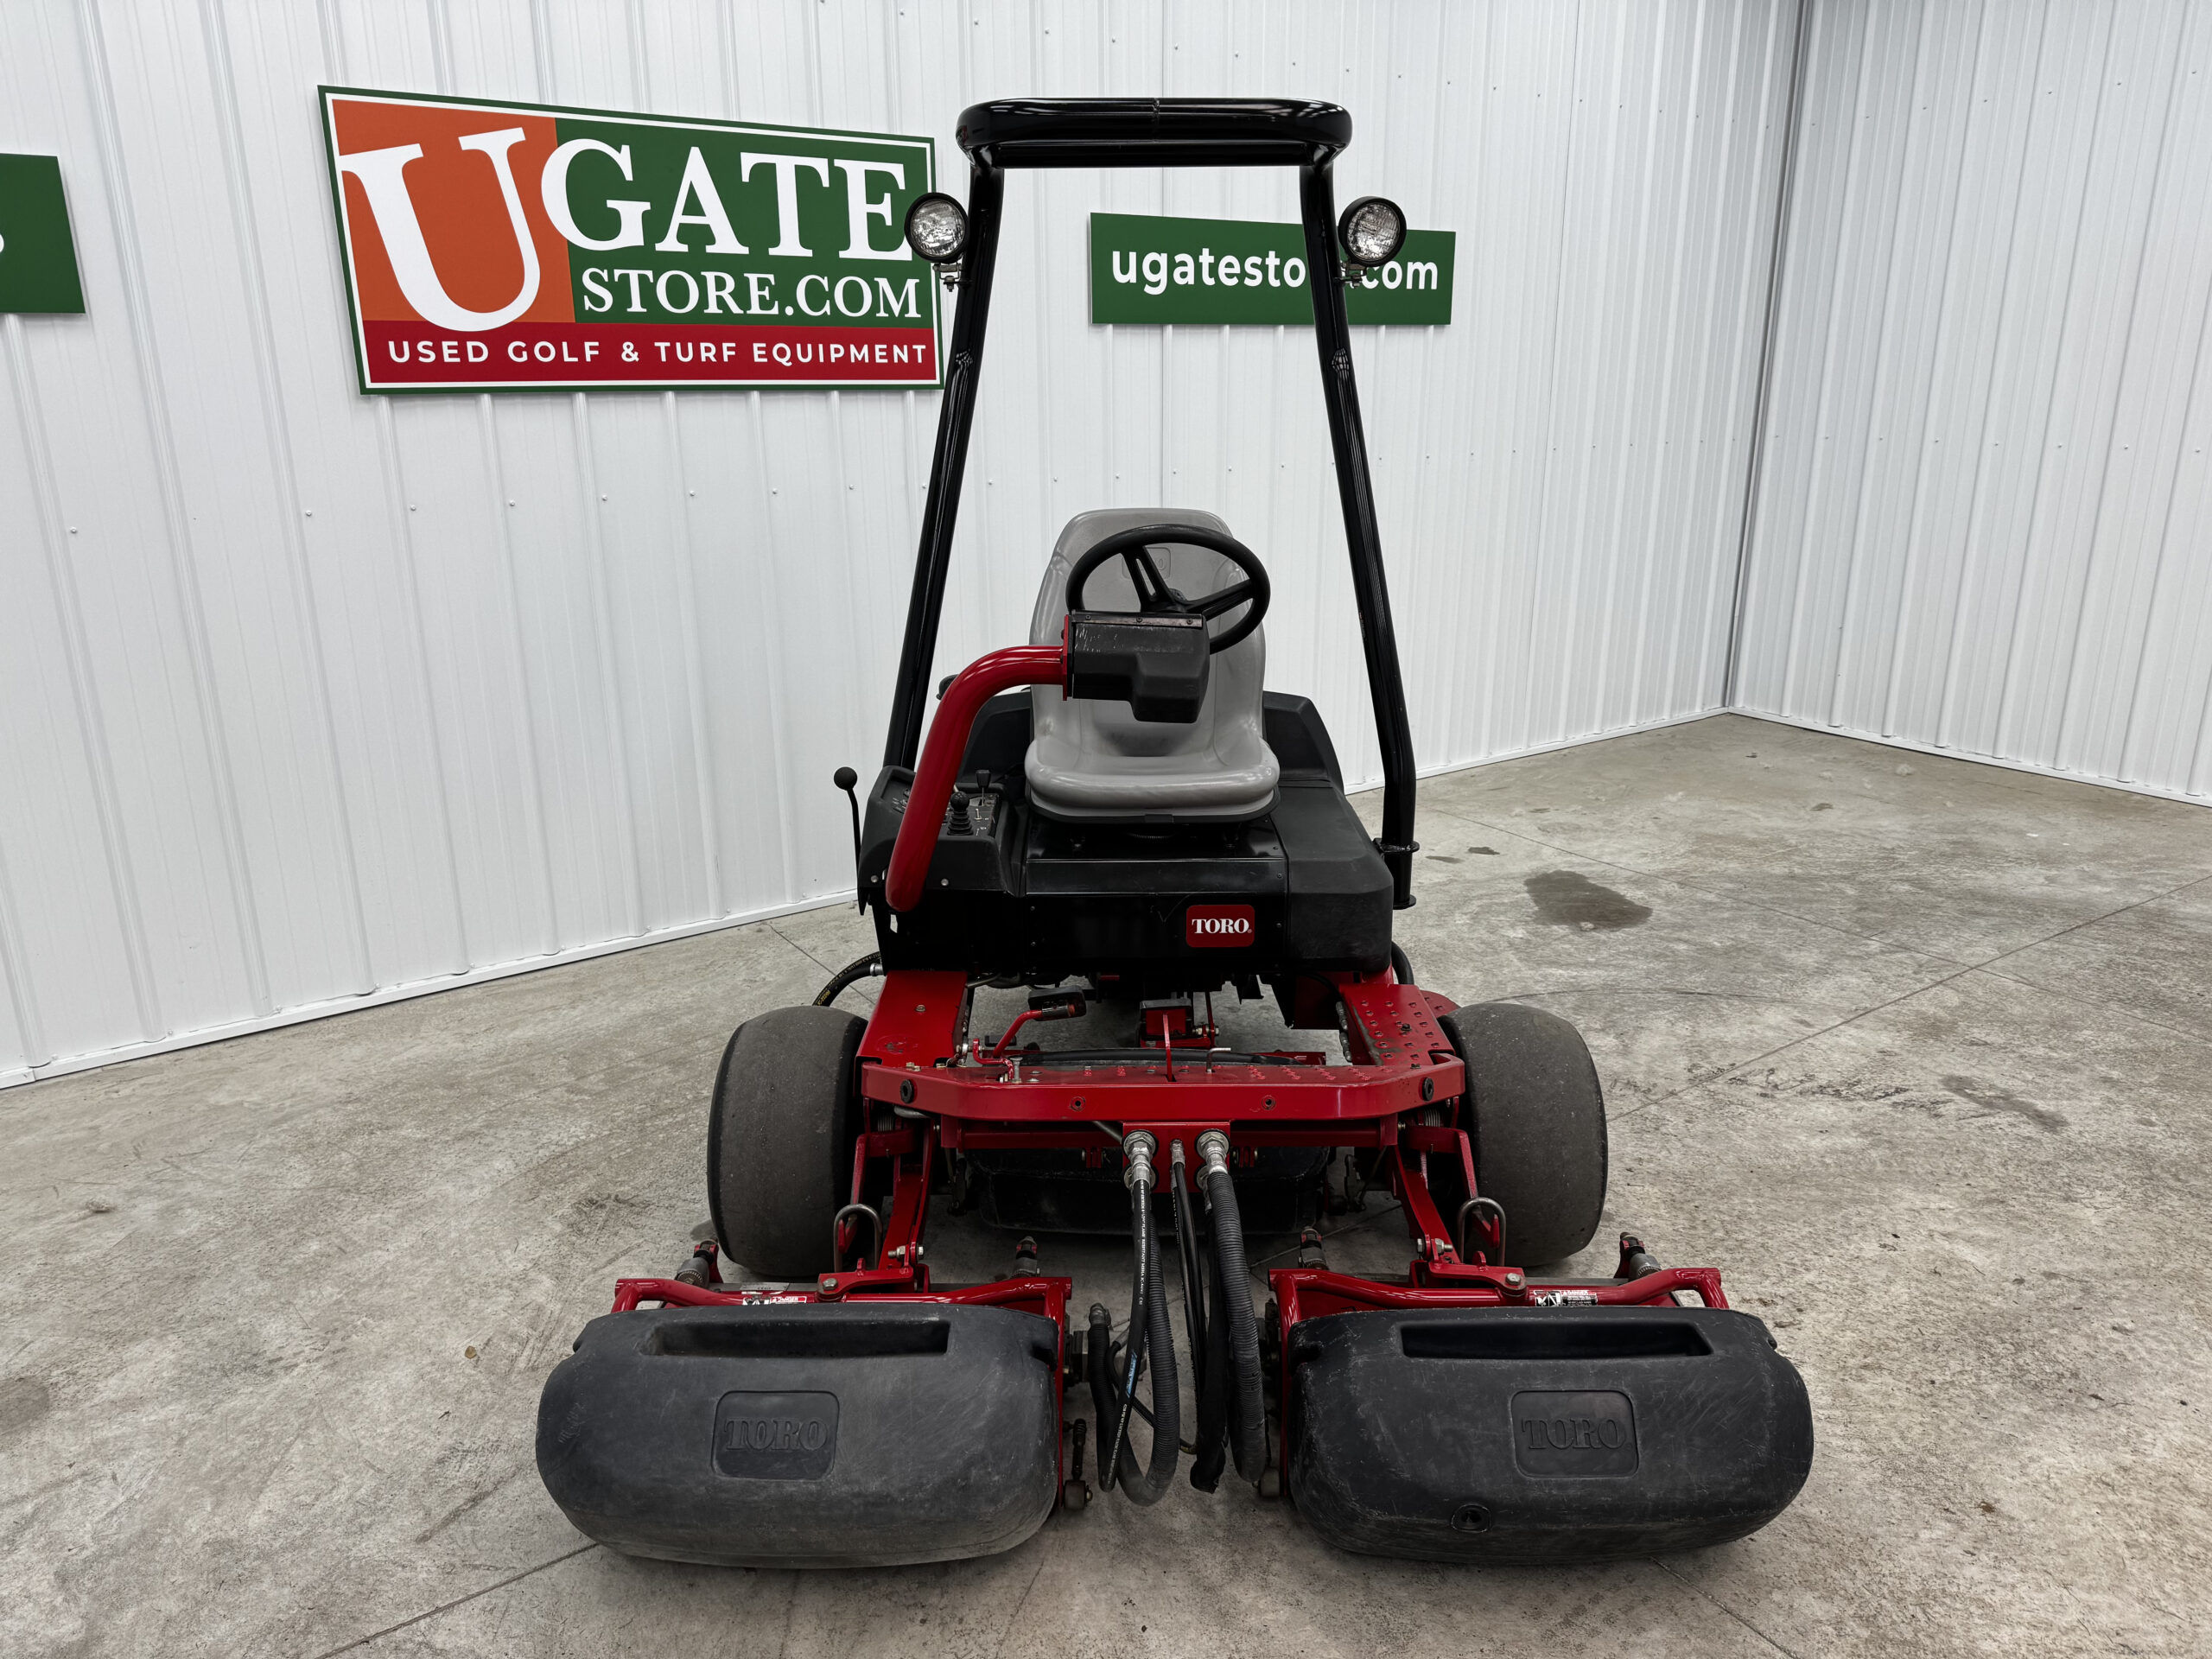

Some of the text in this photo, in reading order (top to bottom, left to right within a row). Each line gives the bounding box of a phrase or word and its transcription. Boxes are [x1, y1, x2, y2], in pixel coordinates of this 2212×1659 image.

[582, 267, 922, 319] STORE.COM
[388, 340, 927, 367] USED GOLF & TURF EQUIPMENT
[1192, 918, 1250, 934] TORO
[724, 1417, 829, 1452] TORO
[1522, 1418, 1627, 1450] TORO
